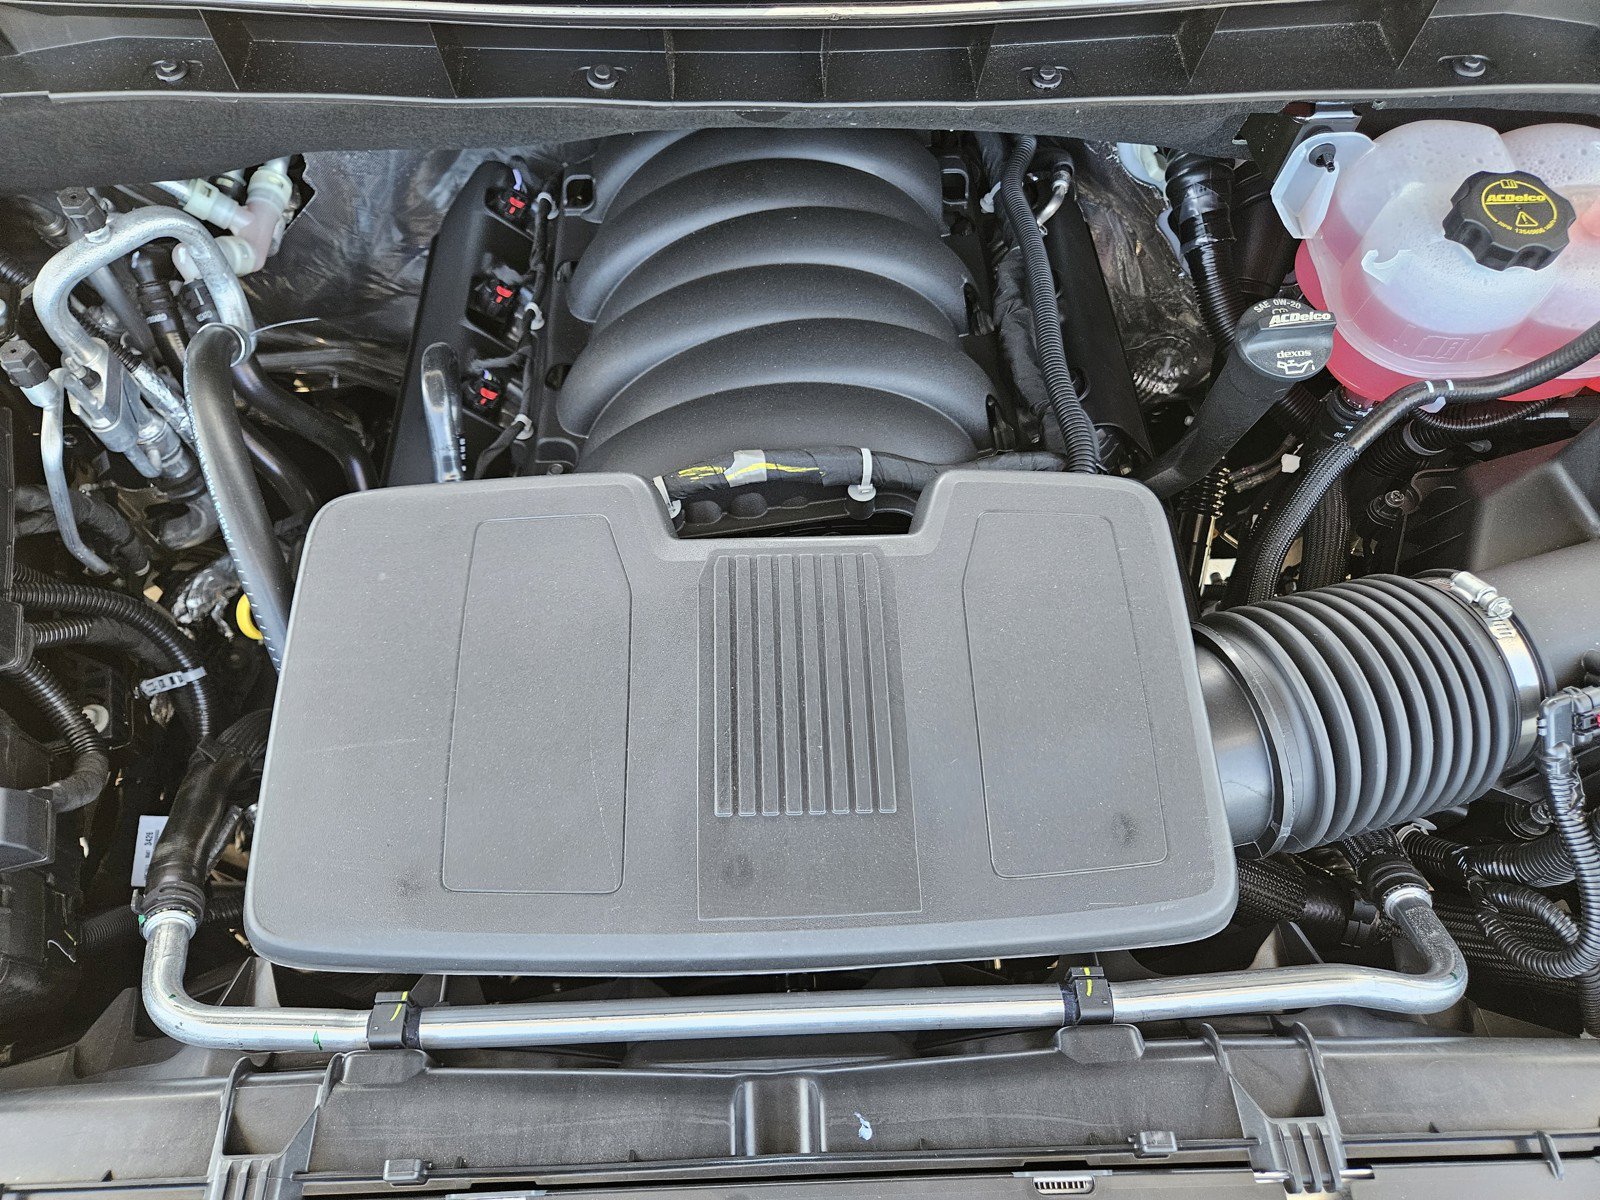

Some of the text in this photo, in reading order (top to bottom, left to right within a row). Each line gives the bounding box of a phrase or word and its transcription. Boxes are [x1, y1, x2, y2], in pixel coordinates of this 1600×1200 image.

[1486, 193, 1547, 202] ACDelco
[1253, 298, 1302, 313] SAE 0W-20
[1268, 311, 1332, 325] ACDelco
[1276, 349, 1312, 359] dexos
